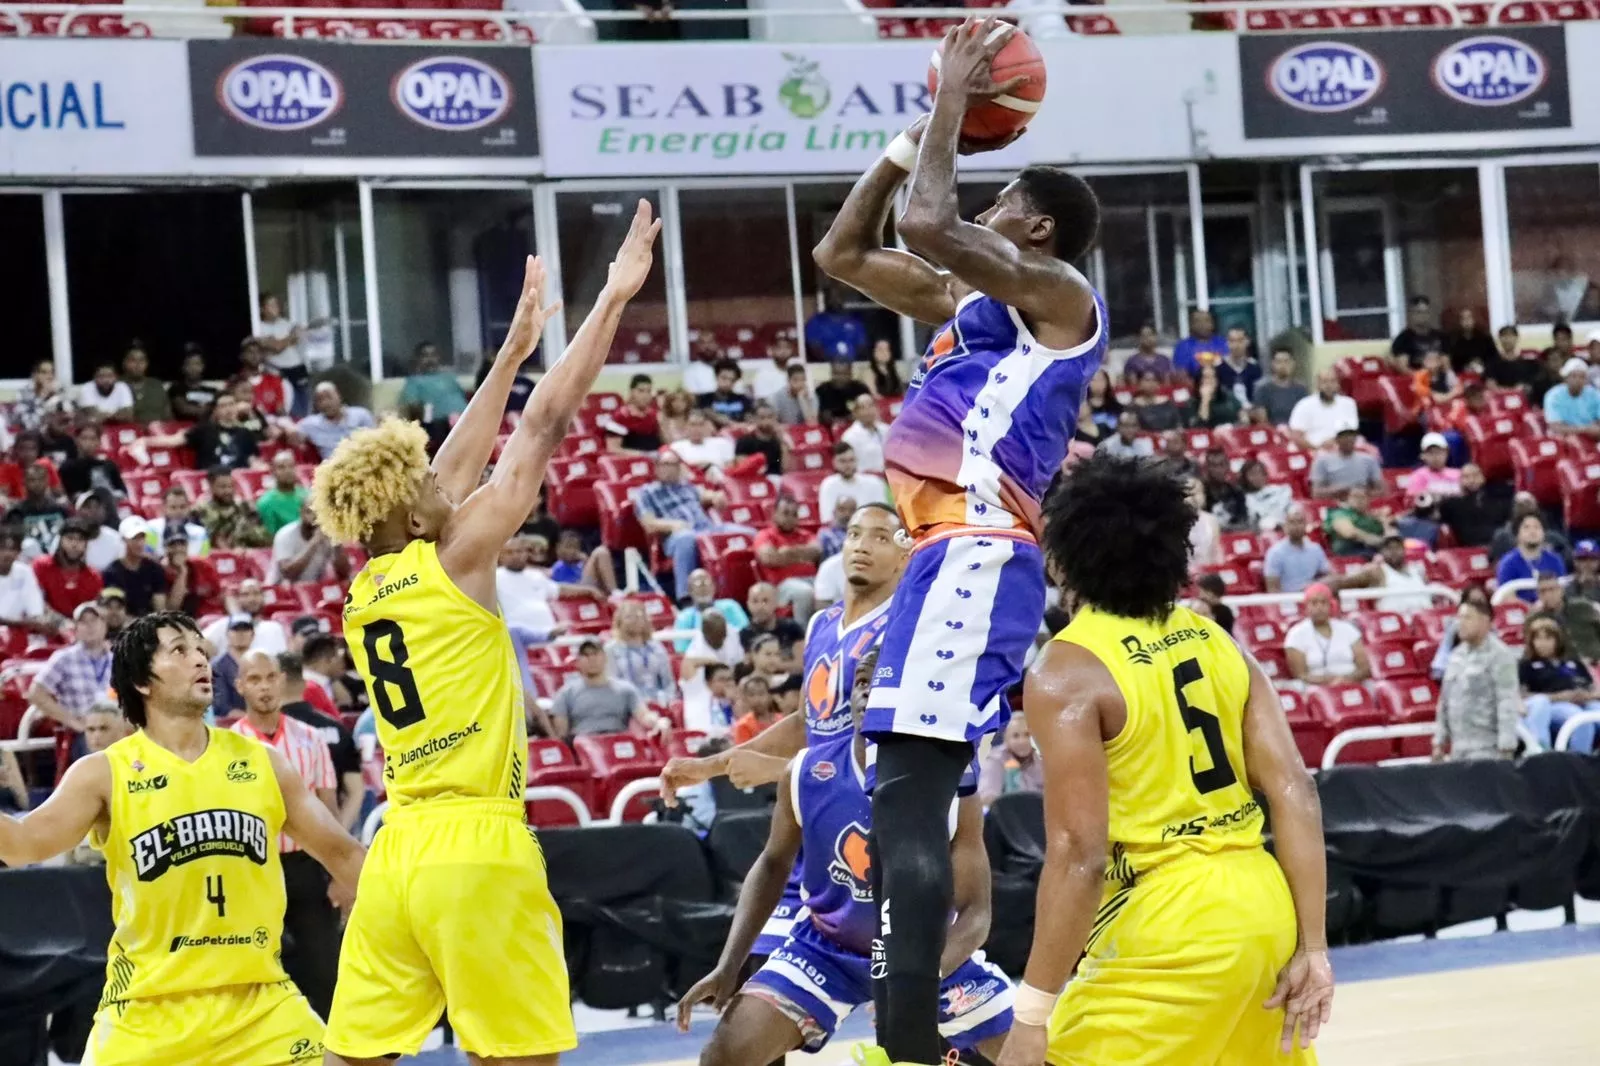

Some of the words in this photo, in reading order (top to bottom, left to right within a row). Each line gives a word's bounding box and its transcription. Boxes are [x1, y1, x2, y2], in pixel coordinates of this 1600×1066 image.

[1280, 55, 1376, 93] OPAL
[1445, 50, 1537, 87] OPAL
[0, 81, 125, 130] CIAL
[231, 70, 332, 109] OPAL
[403, 71, 503, 109] OPAL
[598, 124, 787, 159] Energía
[804, 124, 900, 152] Lim
[362, 618, 427, 731] 8
[1172, 657, 1237, 795] 5
[133, 827, 172, 877] EL
[174, 810, 267, 861] BARIAS
[170, 844, 198, 862] VILLA
[199, 840, 246, 853] CONSUELO
[206, 874, 226, 917] 4
